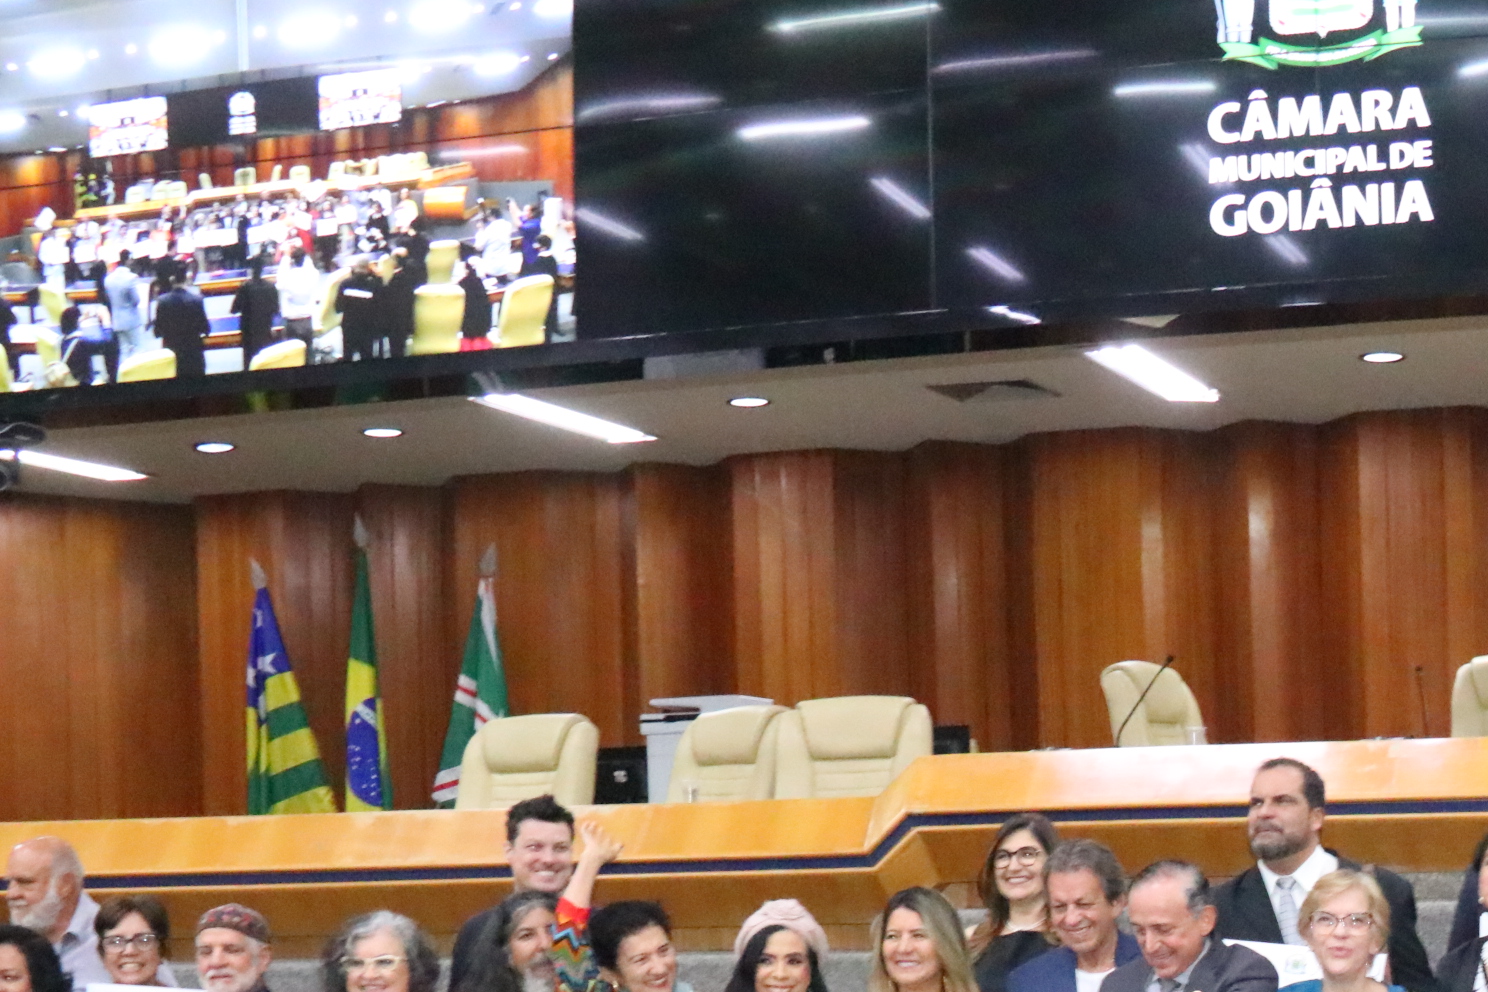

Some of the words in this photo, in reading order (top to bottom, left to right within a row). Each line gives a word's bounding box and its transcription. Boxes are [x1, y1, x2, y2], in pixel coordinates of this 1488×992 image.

[1207, 87, 1432, 144] CÂMARA
[1208, 144, 1387, 184] MUNICIPAL
[1389, 140, 1433, 170] DE
[1209, 177, 1434, 237] GOIÂNIA
